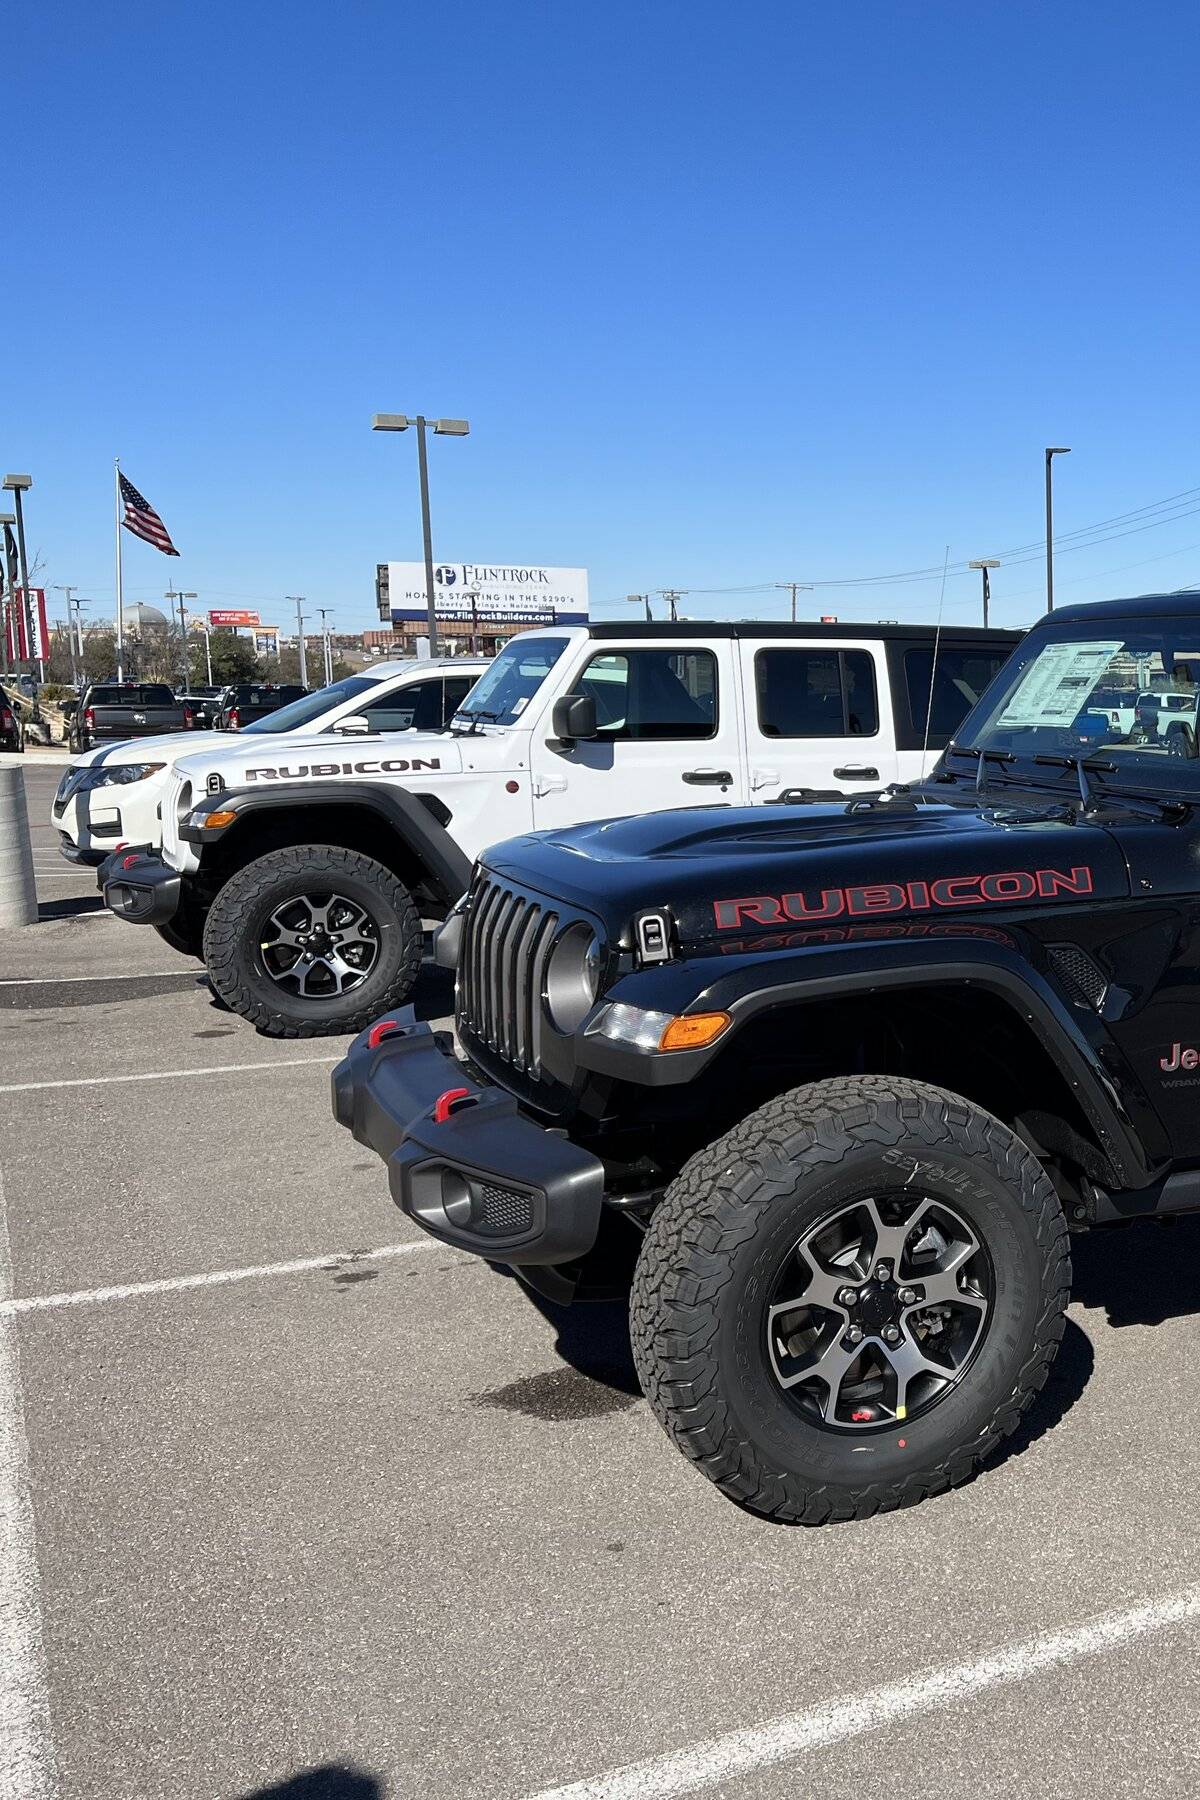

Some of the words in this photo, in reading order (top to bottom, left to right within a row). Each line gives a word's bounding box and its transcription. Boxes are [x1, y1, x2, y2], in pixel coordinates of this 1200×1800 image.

[462, 564, 550, 585] FLINTROCK
[405, 591, 444, 600] HOS
[504, 594, 515, 602] IN
[518, 594, 538, 602] THE
[435, 601, 464, 609] iberty
[466, 601, 500, 609] Srings
[434, 611, 554, 622] www.FlinrockBuilders.com
[245, 757, 441, 782] RUBICON
[713, 866, 1093, 930] RUBICON
